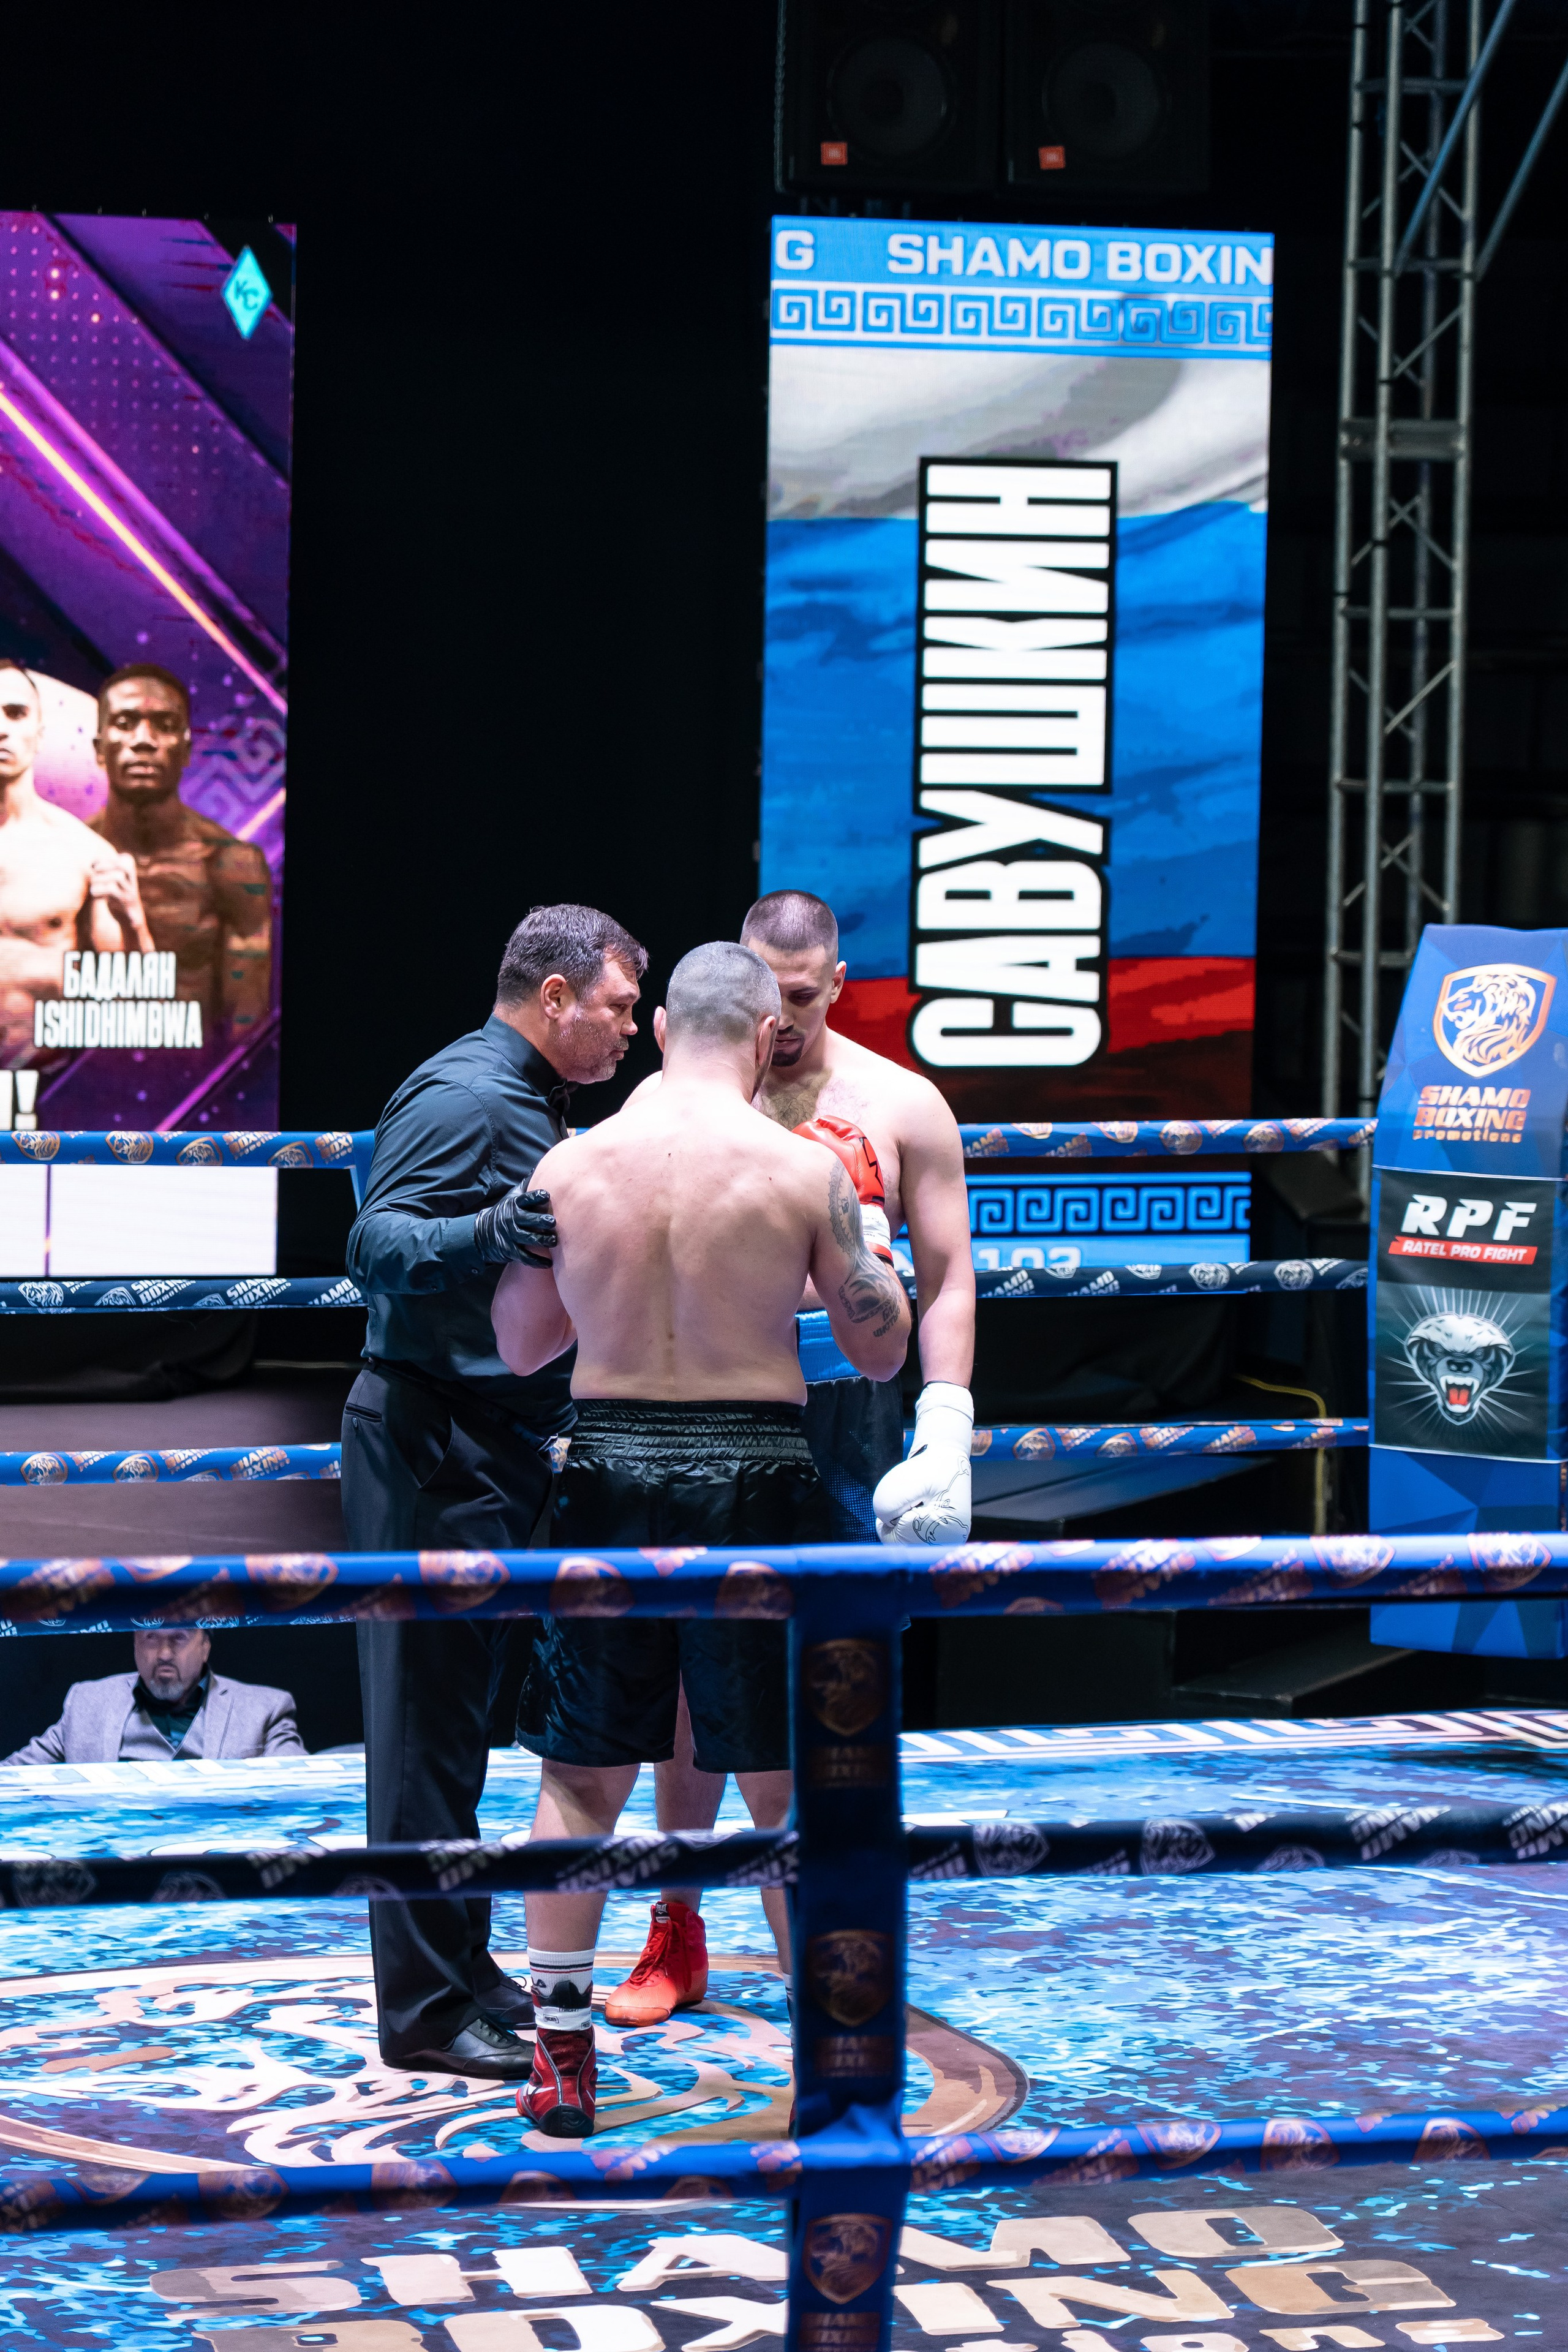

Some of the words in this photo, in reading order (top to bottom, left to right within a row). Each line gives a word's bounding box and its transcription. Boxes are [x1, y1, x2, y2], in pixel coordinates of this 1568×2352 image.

[775, 230, 815, 271] G
[888, 233, 1091, 279] SHAMO
[1107, 241, 1273, 285] BOXIN
[911, 464, 1112, 1067] САВУШКИН
[63, 951, 176, 1001] БАДАЛЯН
[34, 1000, 203, 1049] ISHIDHIMBWA
[1414, 1107, 1527, 1131] BOXING
[1418, 1085, 1531, 1109] SHAMO
[1401, 1194, 1537, 1241] RPF
[1402, 1239, 1447, 1256] RATEL
[1450, 1245, 1482, 1259] PRO
[1483, 1246, 1528, 1262] FIGHT
